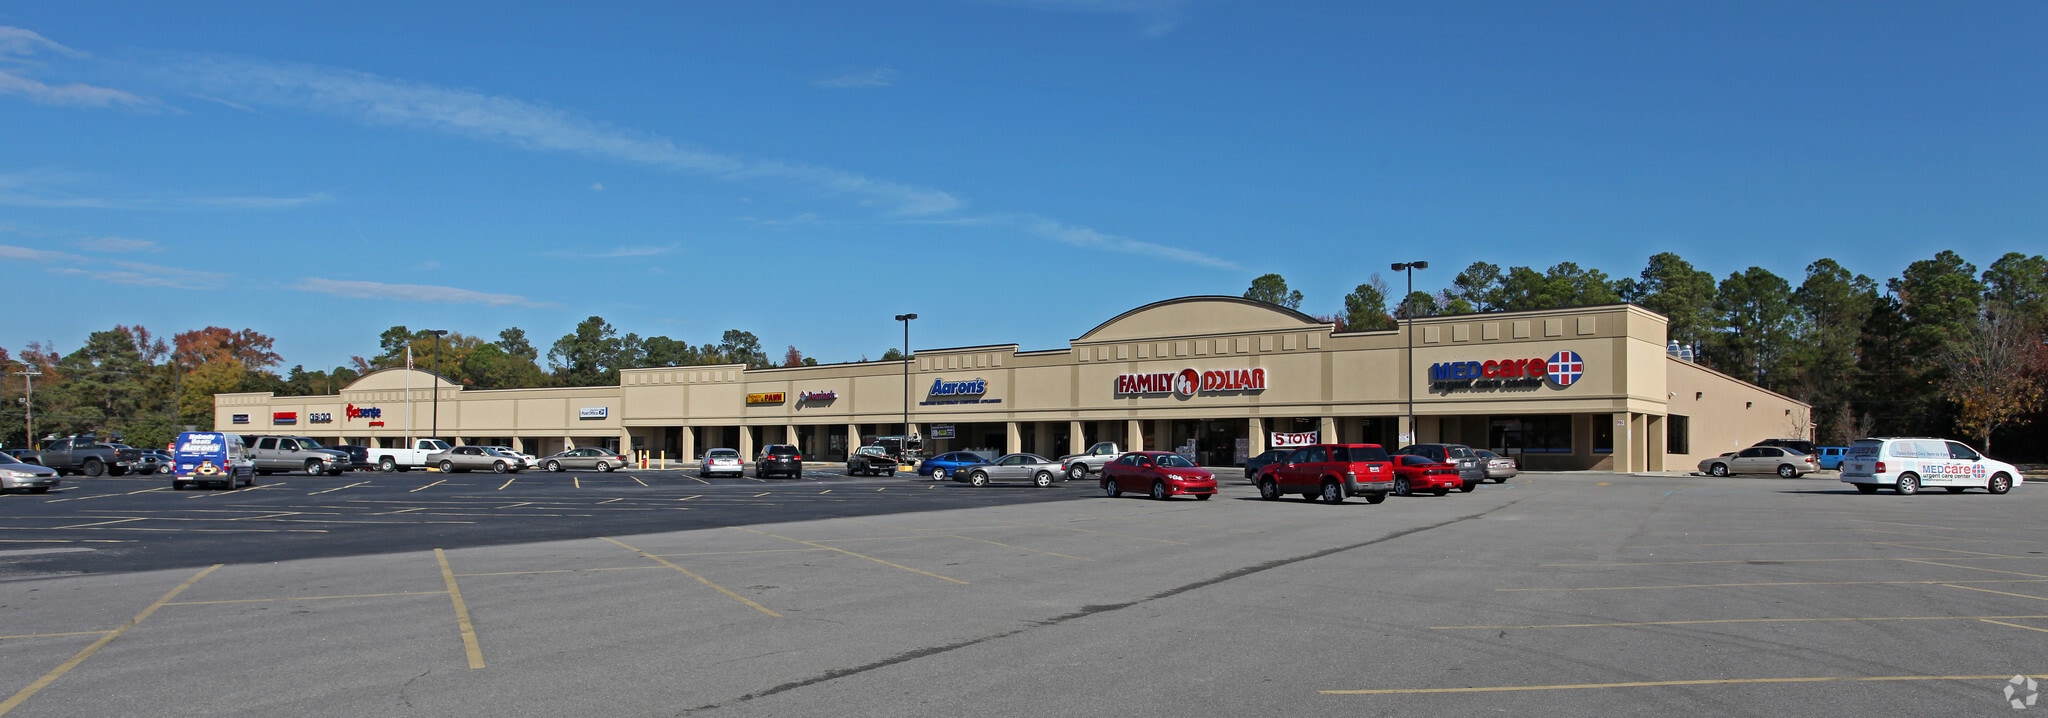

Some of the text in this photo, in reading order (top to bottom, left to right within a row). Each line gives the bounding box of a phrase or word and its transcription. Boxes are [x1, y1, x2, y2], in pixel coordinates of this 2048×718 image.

[1433, 358, 1547, 380] MEDcare
[931, 378, 985, 395] Aaron's
[1118, 368, 1267, 394] FAMILY DOLLAR
[1433, 381, 1472, 391] urgent
[1476, 381, 1501, 389] care
[1287, 433, 1316, 444] TOYS
[180, 442, 221, 452] Aaron's
[1922, 465, 1971, 474] MEDcare
